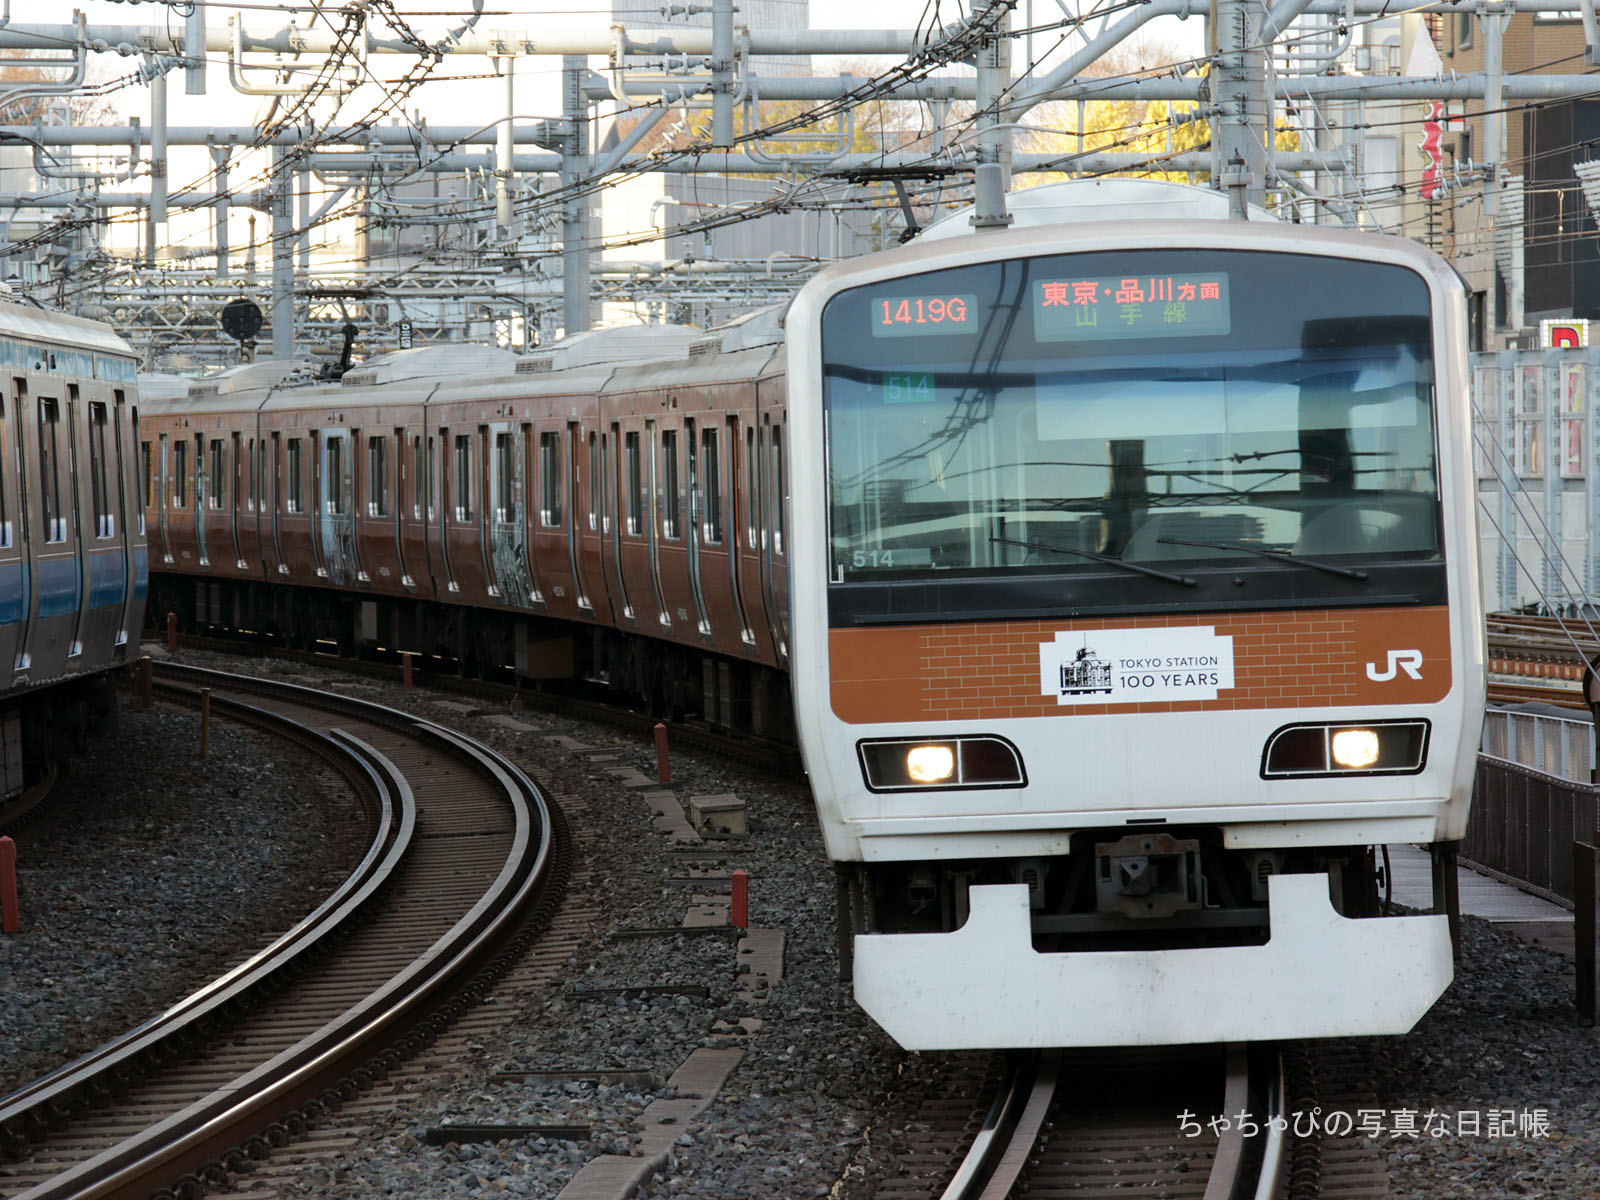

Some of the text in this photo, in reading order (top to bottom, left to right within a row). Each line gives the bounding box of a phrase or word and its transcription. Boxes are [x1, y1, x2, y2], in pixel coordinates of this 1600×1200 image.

[1041, 277, 1221, 307] 東京・品川方面
[881, 297, 968, 326] 1419G
[888, 375, 930, 400] 514
[853, 550, 895, 568] 514
[1119, 656, 1218, 669] TOKYO STATION
[1366, 649, 1423, 682] JR
[1120, 673, 1219, 688] 100 YEARS
